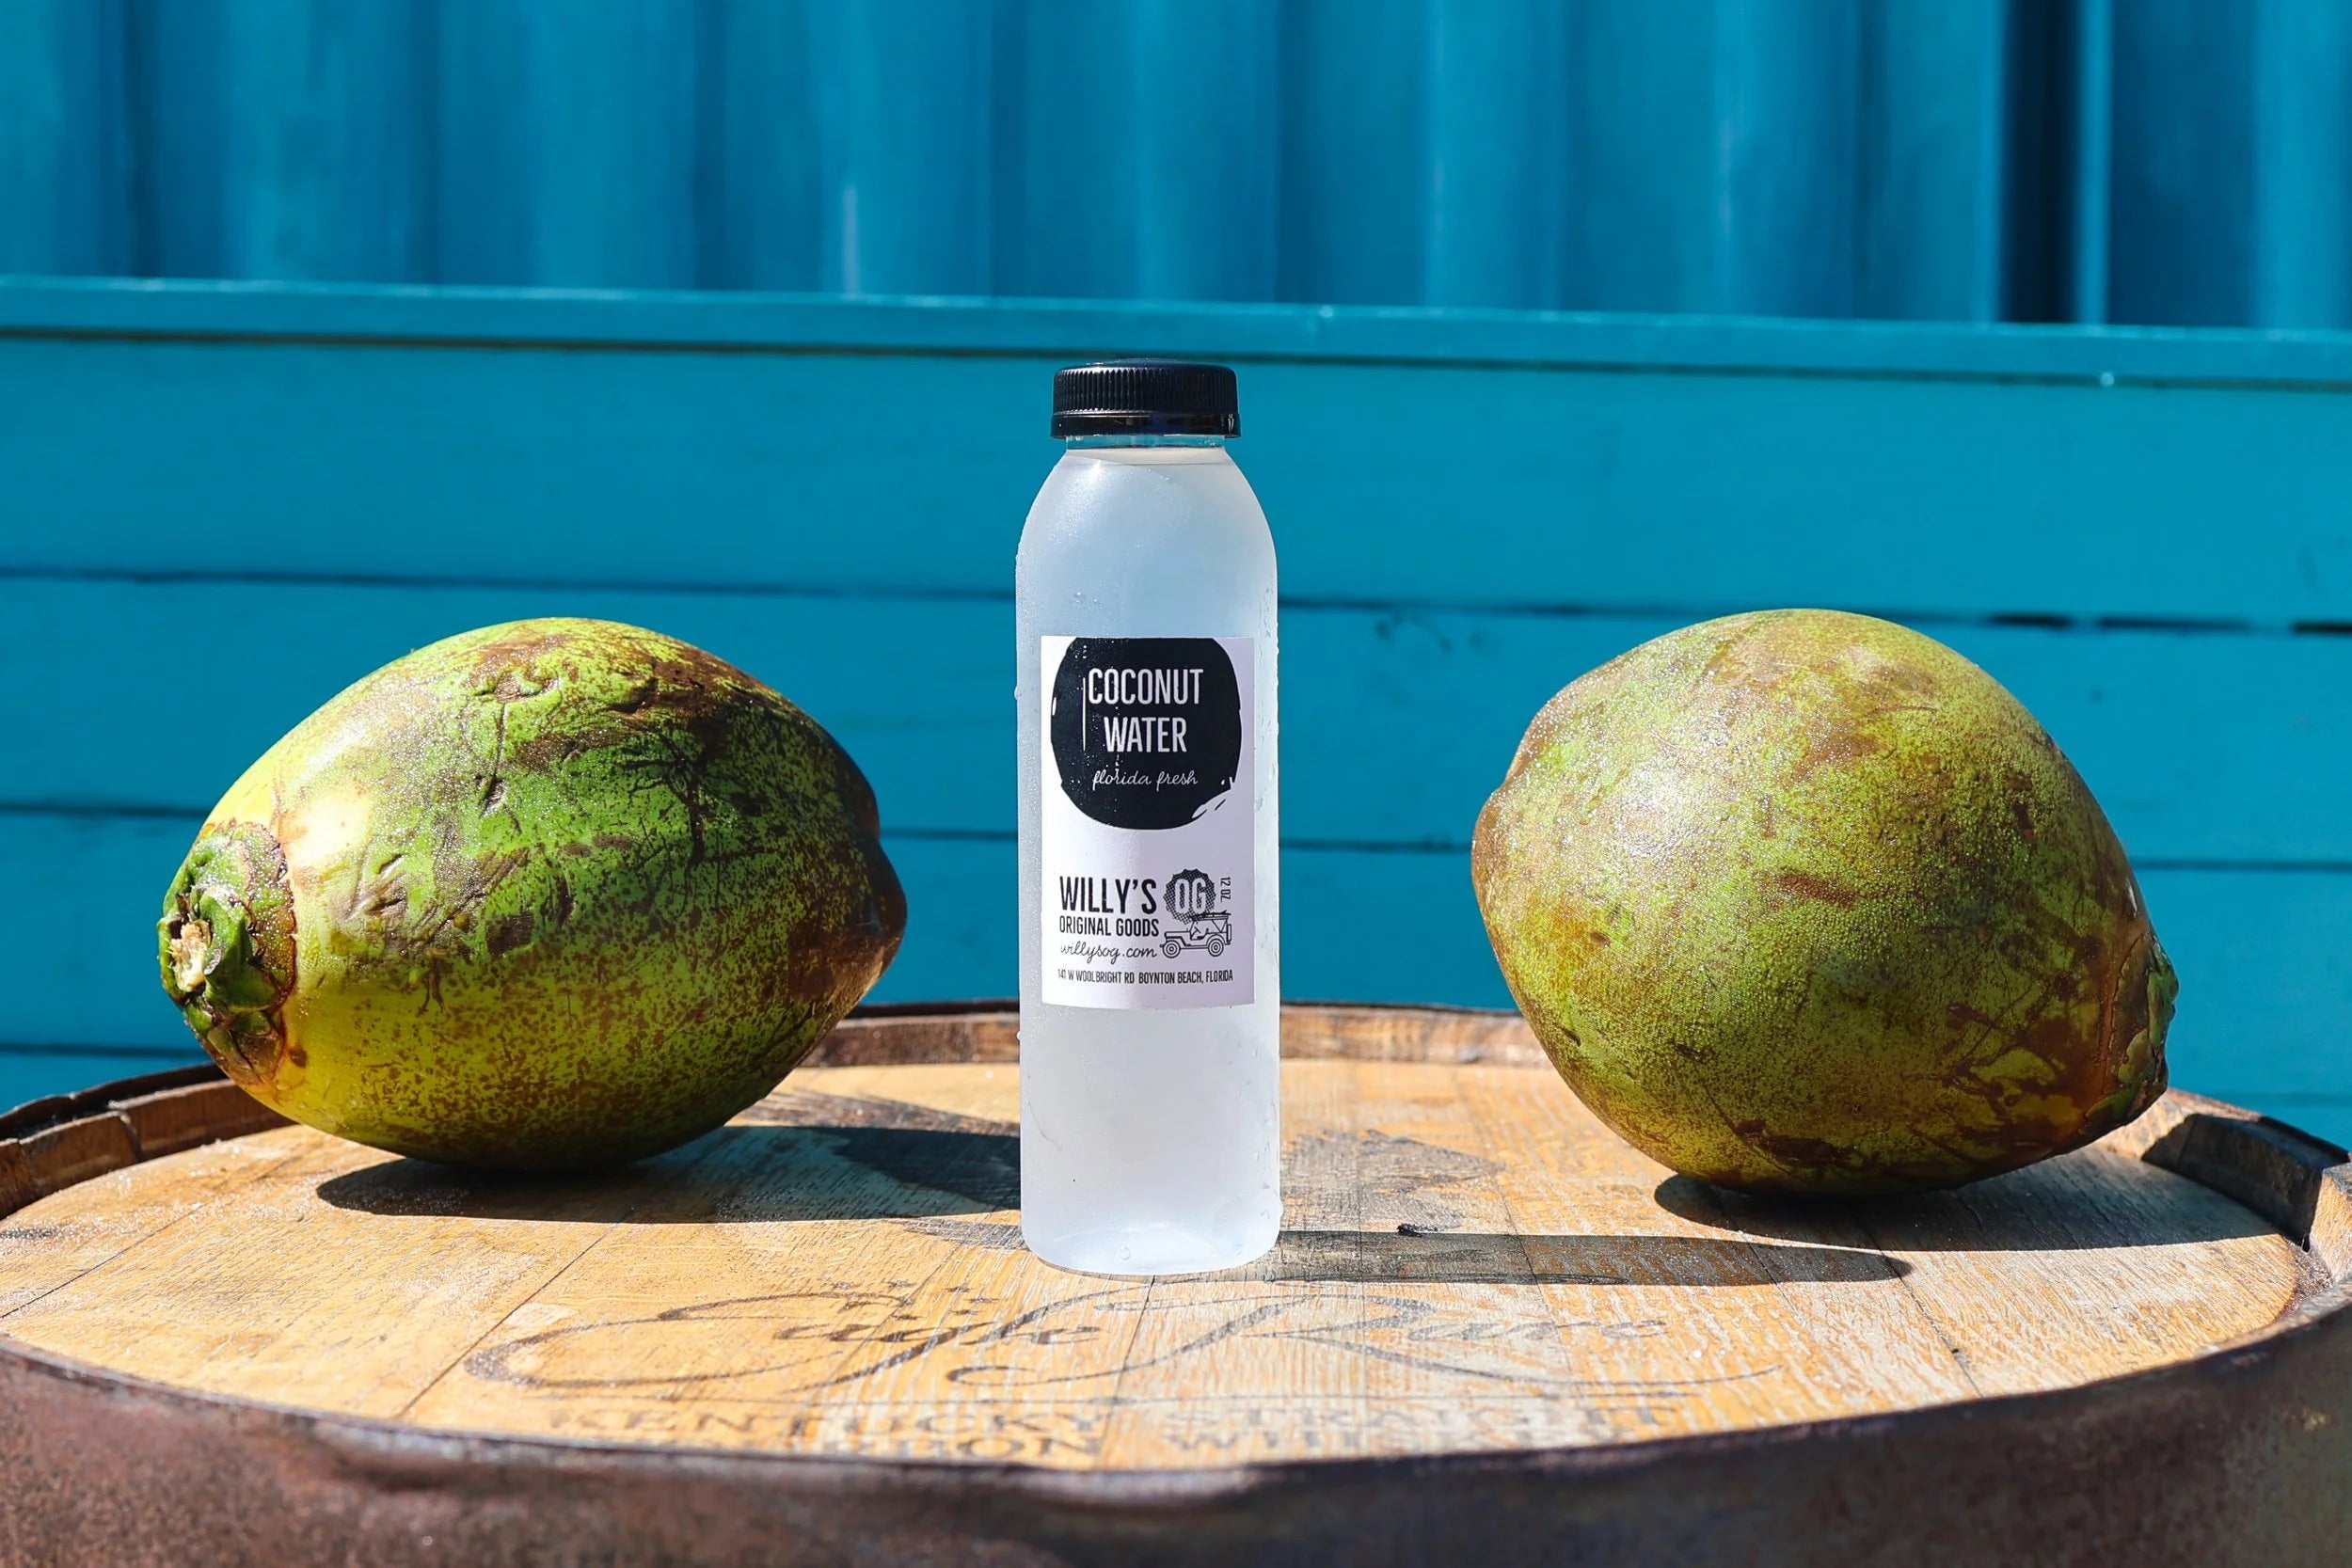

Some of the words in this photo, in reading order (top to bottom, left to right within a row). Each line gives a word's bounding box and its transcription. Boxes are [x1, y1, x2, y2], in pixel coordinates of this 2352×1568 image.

[1088, 668, 1203, 705] COCONUT
[1104, 716, 1187, 752] WATER
[1092, 768, 1152, 791] florida
[1156, 769, 1199, 792] fresh
[1220, 877, 1232, 886] 12
[1059, 876, 1157, 914] WILLY'S
[1174, 878, 1207, 914] OG
[1059, 915, 1111, 936] ORIGINAL
[1116, 918, 1159, 937] GOODS
[1060, 941, 1157, 964] willysog.com
[1068, 969, 1074, 981] W
[1075, 970, 1122, 984] WOOLBRIGHT
[1124, 972, 1135, 984] RD
[1138, 972, 1175, 984] BOYNTON
[1177, 972, 1203, 984] BEACH,
[1205, 970, 1233, 983] FLORIDA
